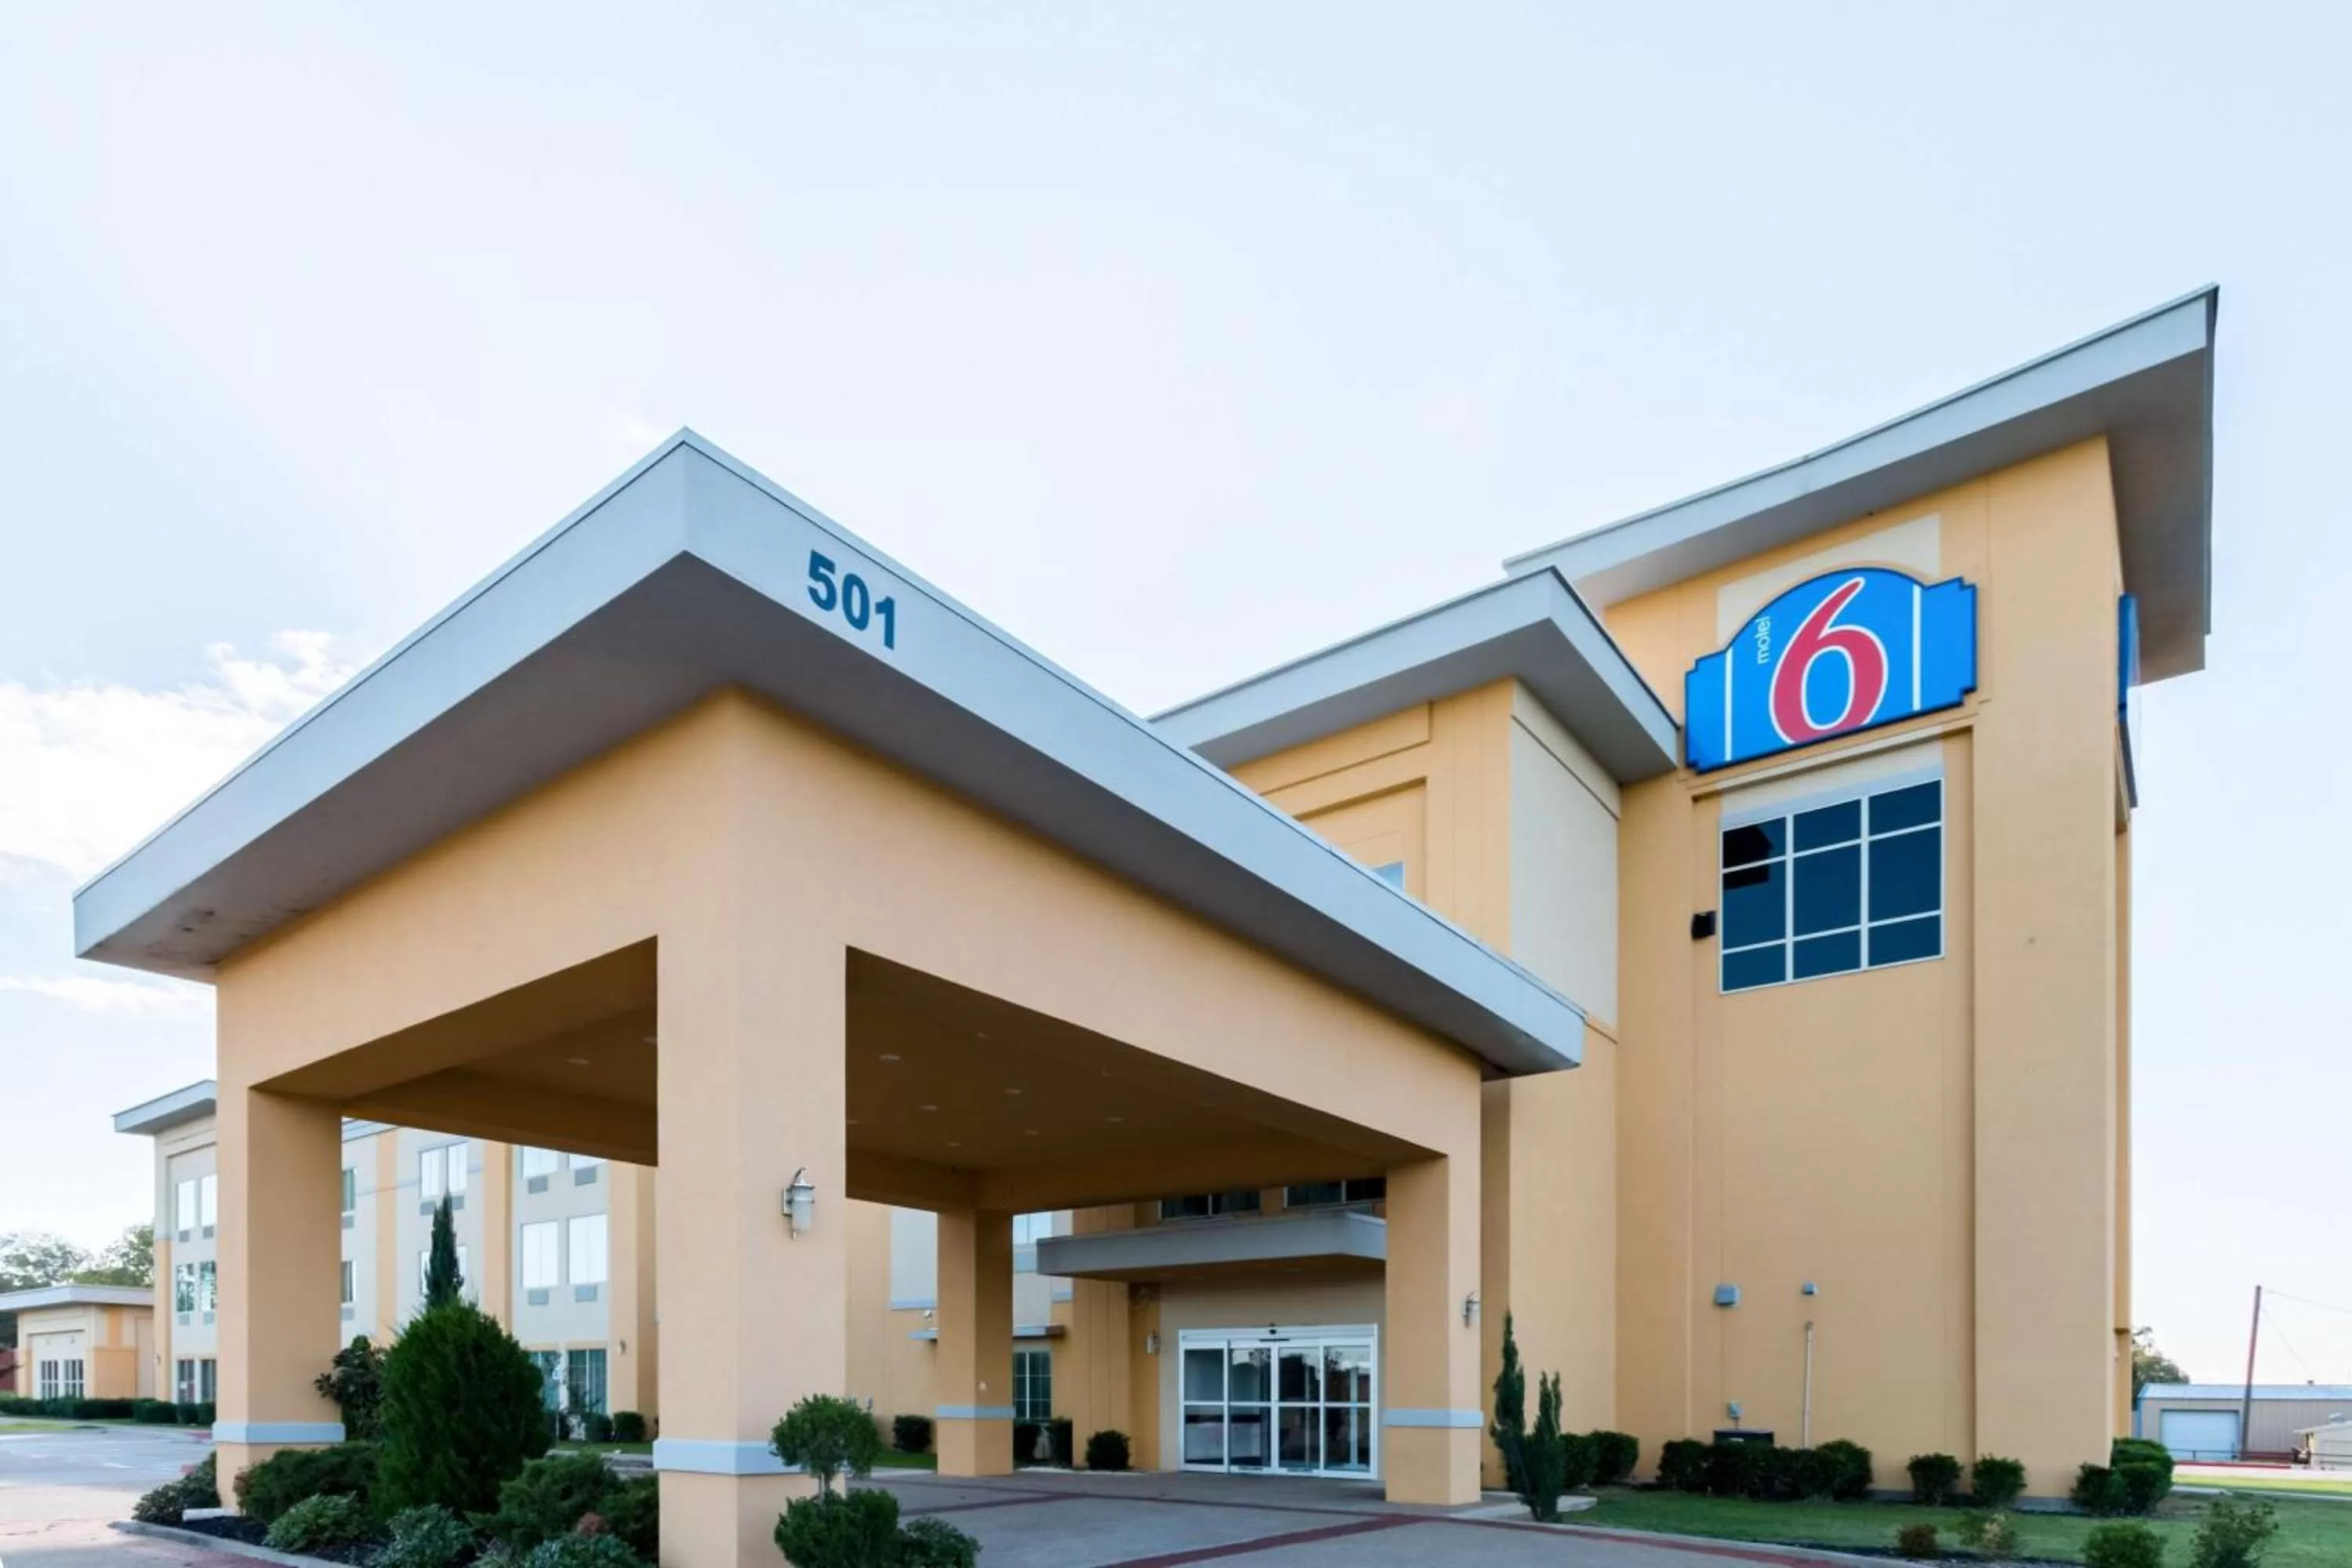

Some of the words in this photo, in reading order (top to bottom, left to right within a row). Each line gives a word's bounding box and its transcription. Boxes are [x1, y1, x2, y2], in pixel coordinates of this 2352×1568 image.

[808, 550, 895, 650] 501
[1754, 615, 1770, 665] motel
[1769, 576, 1888, 744] 6
